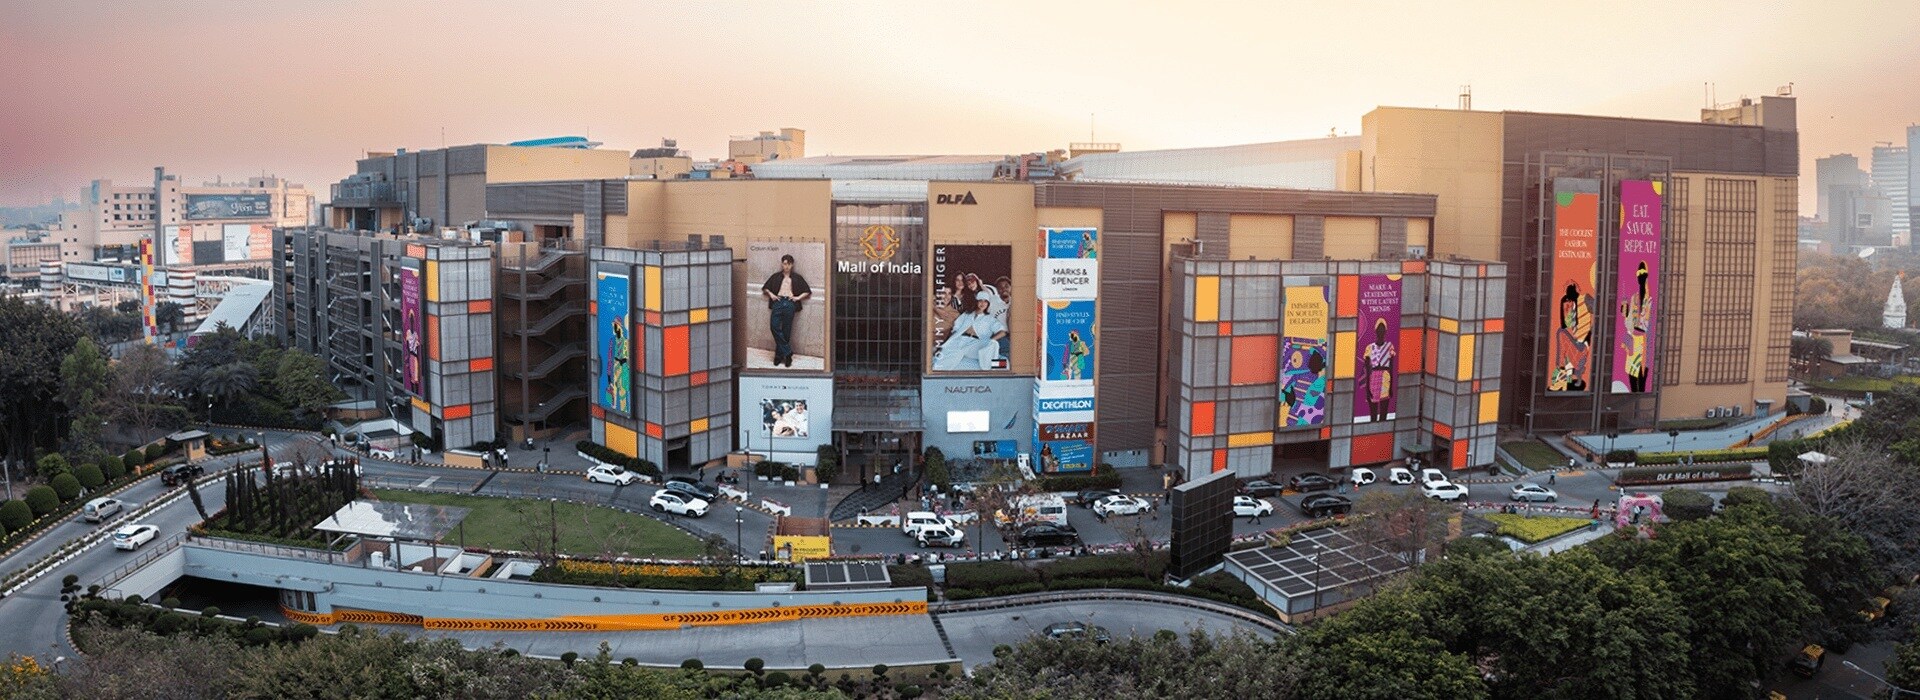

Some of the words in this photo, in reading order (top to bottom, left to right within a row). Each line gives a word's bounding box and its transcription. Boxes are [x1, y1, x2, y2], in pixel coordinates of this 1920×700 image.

[937, 194, 963, 204] DLF
[1570, 229, 1594, 237] COOLEST
[1624, 240, 1657, 253] REPEAT!
[1559, 250, 1592, 258] DESTINATION
[837, 261, 866, 273] Mall
[870, 261, 884, 273] of
[888, 262, 922, 274] India
[1053, 268, 1081, 276] MARKS
[1082, 268, 1088, 276] &
[936, 246, 946, 308] HILFIGER
[1051, 277, 1090, 285] SPENCER
[1042, 400, 1091, 409] DECATHLON
[1675, 472, 1690, 480] Mall
[1692, 471, 1701, 479] of
[1702, 471, 1719, 479] India
